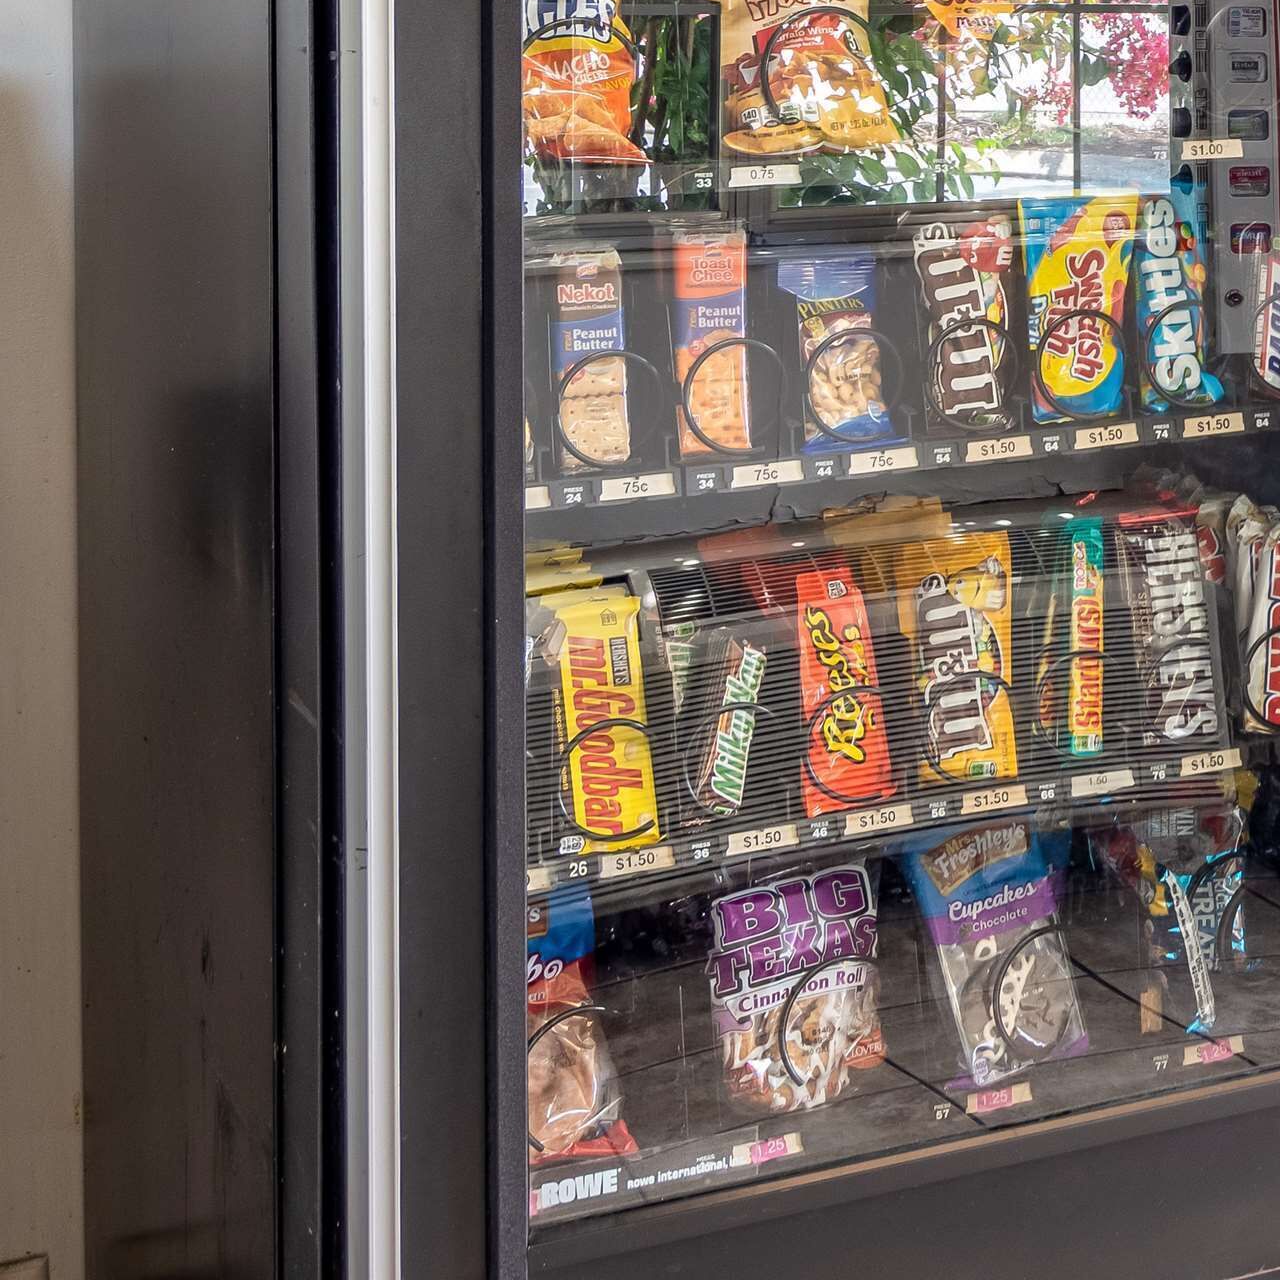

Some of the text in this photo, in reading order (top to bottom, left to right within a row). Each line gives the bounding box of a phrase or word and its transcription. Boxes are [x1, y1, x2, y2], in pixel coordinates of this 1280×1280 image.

[1190, 143, 1223, 156] $1.00
[750, 169, 775, 180] 0.75
[696, 178, 713, 188] 33
[690, 256, 733, 271] Toast
[692, 269, 734, 283] Chee
[557, 283, 615, 304] Nekot
[1140, 199, 1201, 393] Skittles
[698, 305, 741, 316] Peanut
[797, 297, 865, 320] PLANTERS
[1045, 248, 1106, 382] Swedish Fish
[698, 317, 738, 328] Butter
[572, 327, 618, 340] Peanut
[573, 339, 615, 352] Butter
[1196, 417, 1231, 433] $1.50
[1255, 418, 1270, 429] 84
[1088, 428, 1124, 444] $1.50
[1153, 429, 1169, 441] 74
[981, 440, 1016, 456] $1.50
[1043, 441, 1059, 453] 64
[935, 453, 951, 465] 54
[816, 466, 834, 477] 44
[698, 479, 715, 490] 34
[566, 493, 583, 504] 24
[805, 605, 866, 764] Reese's
[1190, 755, 1225, 771] $1.50
[1088, 775, 1108, 786] 1.50
[1151, 771, 1166, 781] 76
[974, 791, 1009, 808] $1.50
[1040, 789, 1055, 800] 66
[859, 810, 897, 828] $1.50
[743, 831, 782, 848] $1.50
[811, 827, 828, 838] 46
[934, 821, 1026, 879] Freshley's
[944, 834, 971, 855] Mrs.
[615, 852, 656, 870] $1.50
[693, 848, 709, 860] 36
[569, 861, 588, 877] 26
[719, 870, 867, 948] BIG
[948, 880, 1038, 922] Cupcakes
[972, 906, 1029, 933] Chocolate
[706, 915, 879, 996] TEXAS
[835, 967, 863, 986] Roll
[1154, 1060, 1168, 1071] 77
[981, 1090, 1008, 1106] 1.25
[541, 1171, 619, 1209] ROWE
[627, 1174, 656, 1190] Rowe
